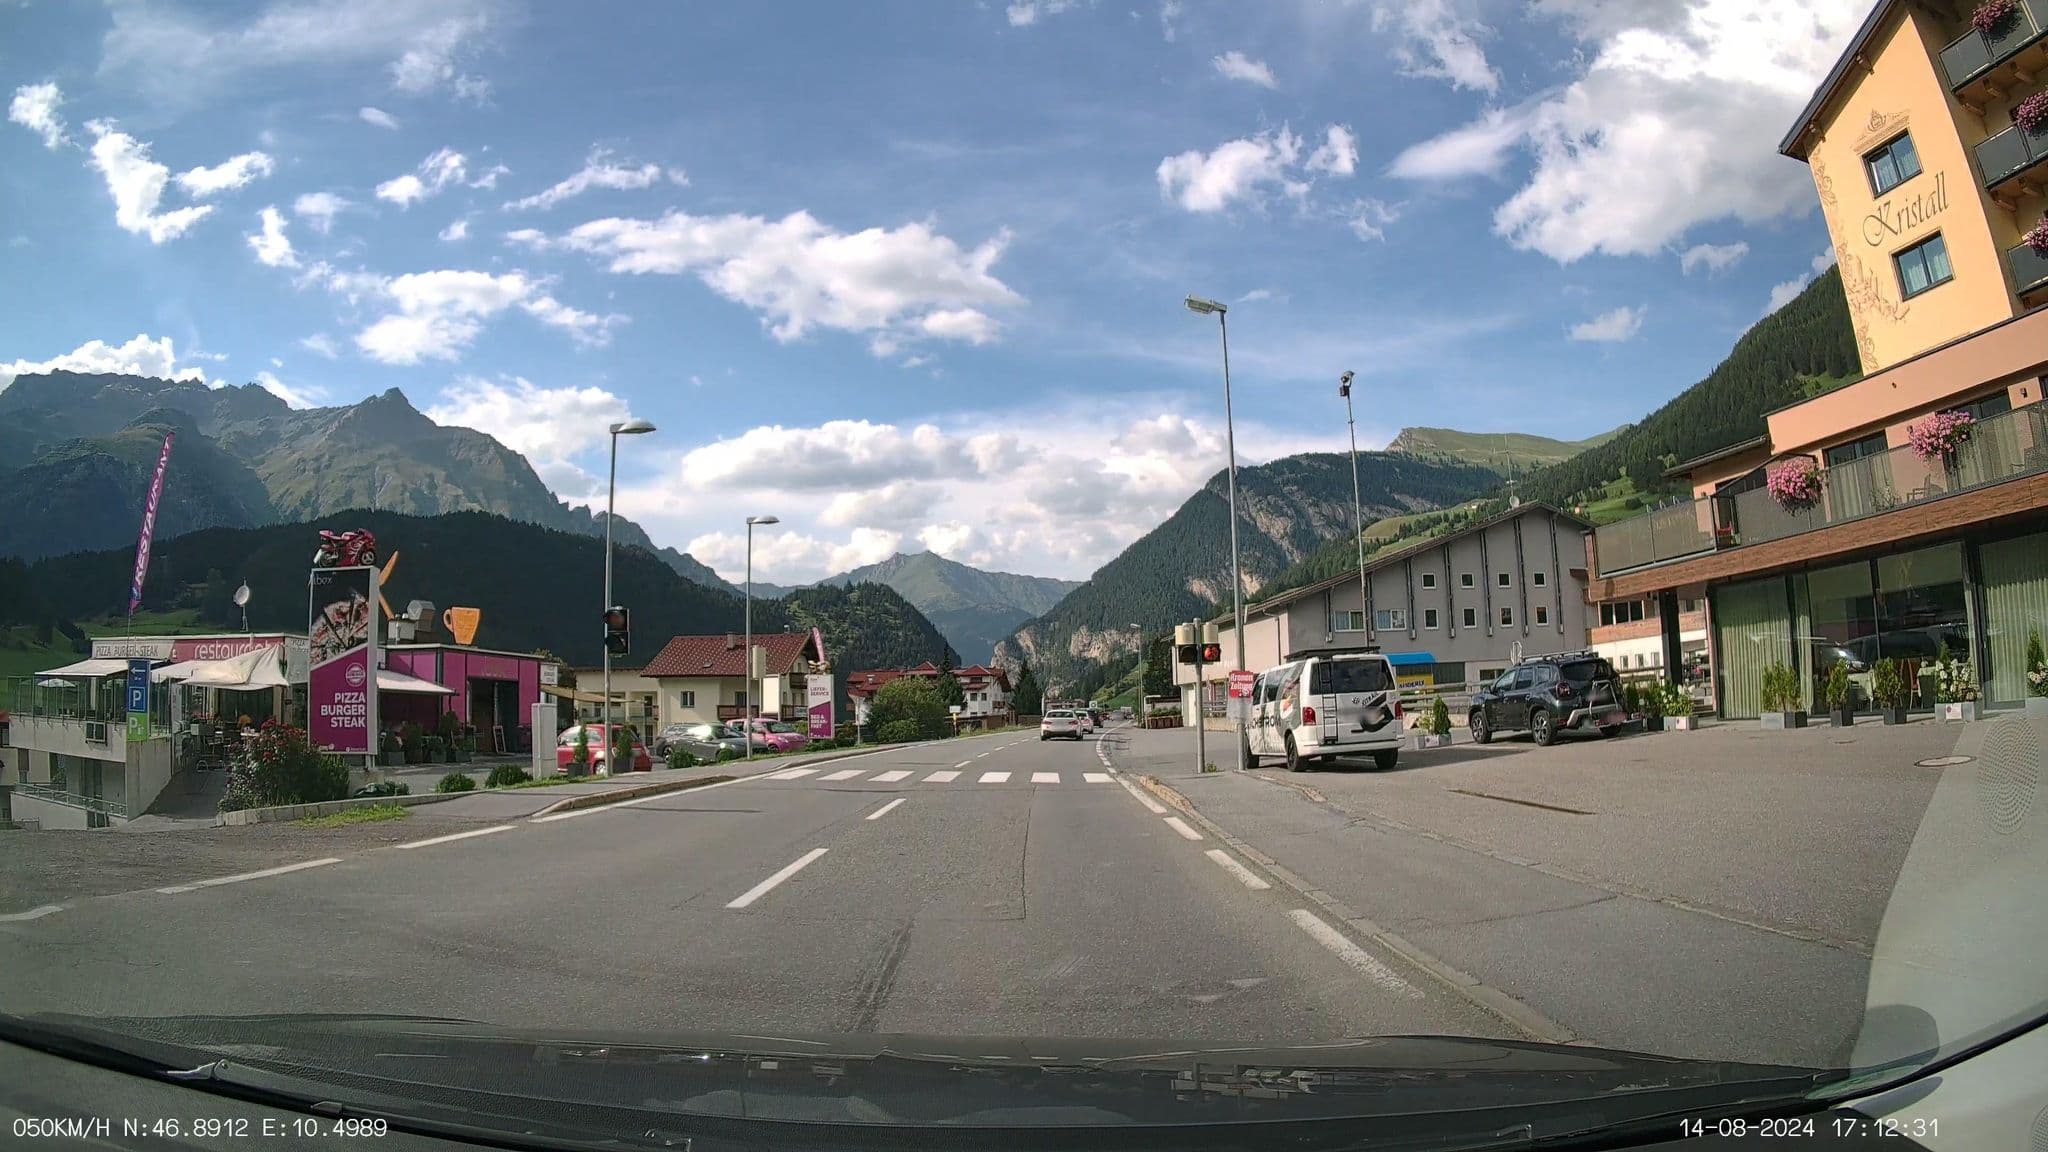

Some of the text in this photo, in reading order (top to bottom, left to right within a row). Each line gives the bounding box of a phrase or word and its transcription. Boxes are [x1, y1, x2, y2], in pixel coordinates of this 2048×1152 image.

[1862, 170, 1949, 247] Kristall
[134, 436, 170, 586] RESTAURANT
[95, 645, 112, 657] PIZZA
[133, 690, 142, 707] P
[334, 692, 366, 704] PIZZA
[321, 704, 366, 716] BURGER
[330, 716, 366, 728] STEAK
